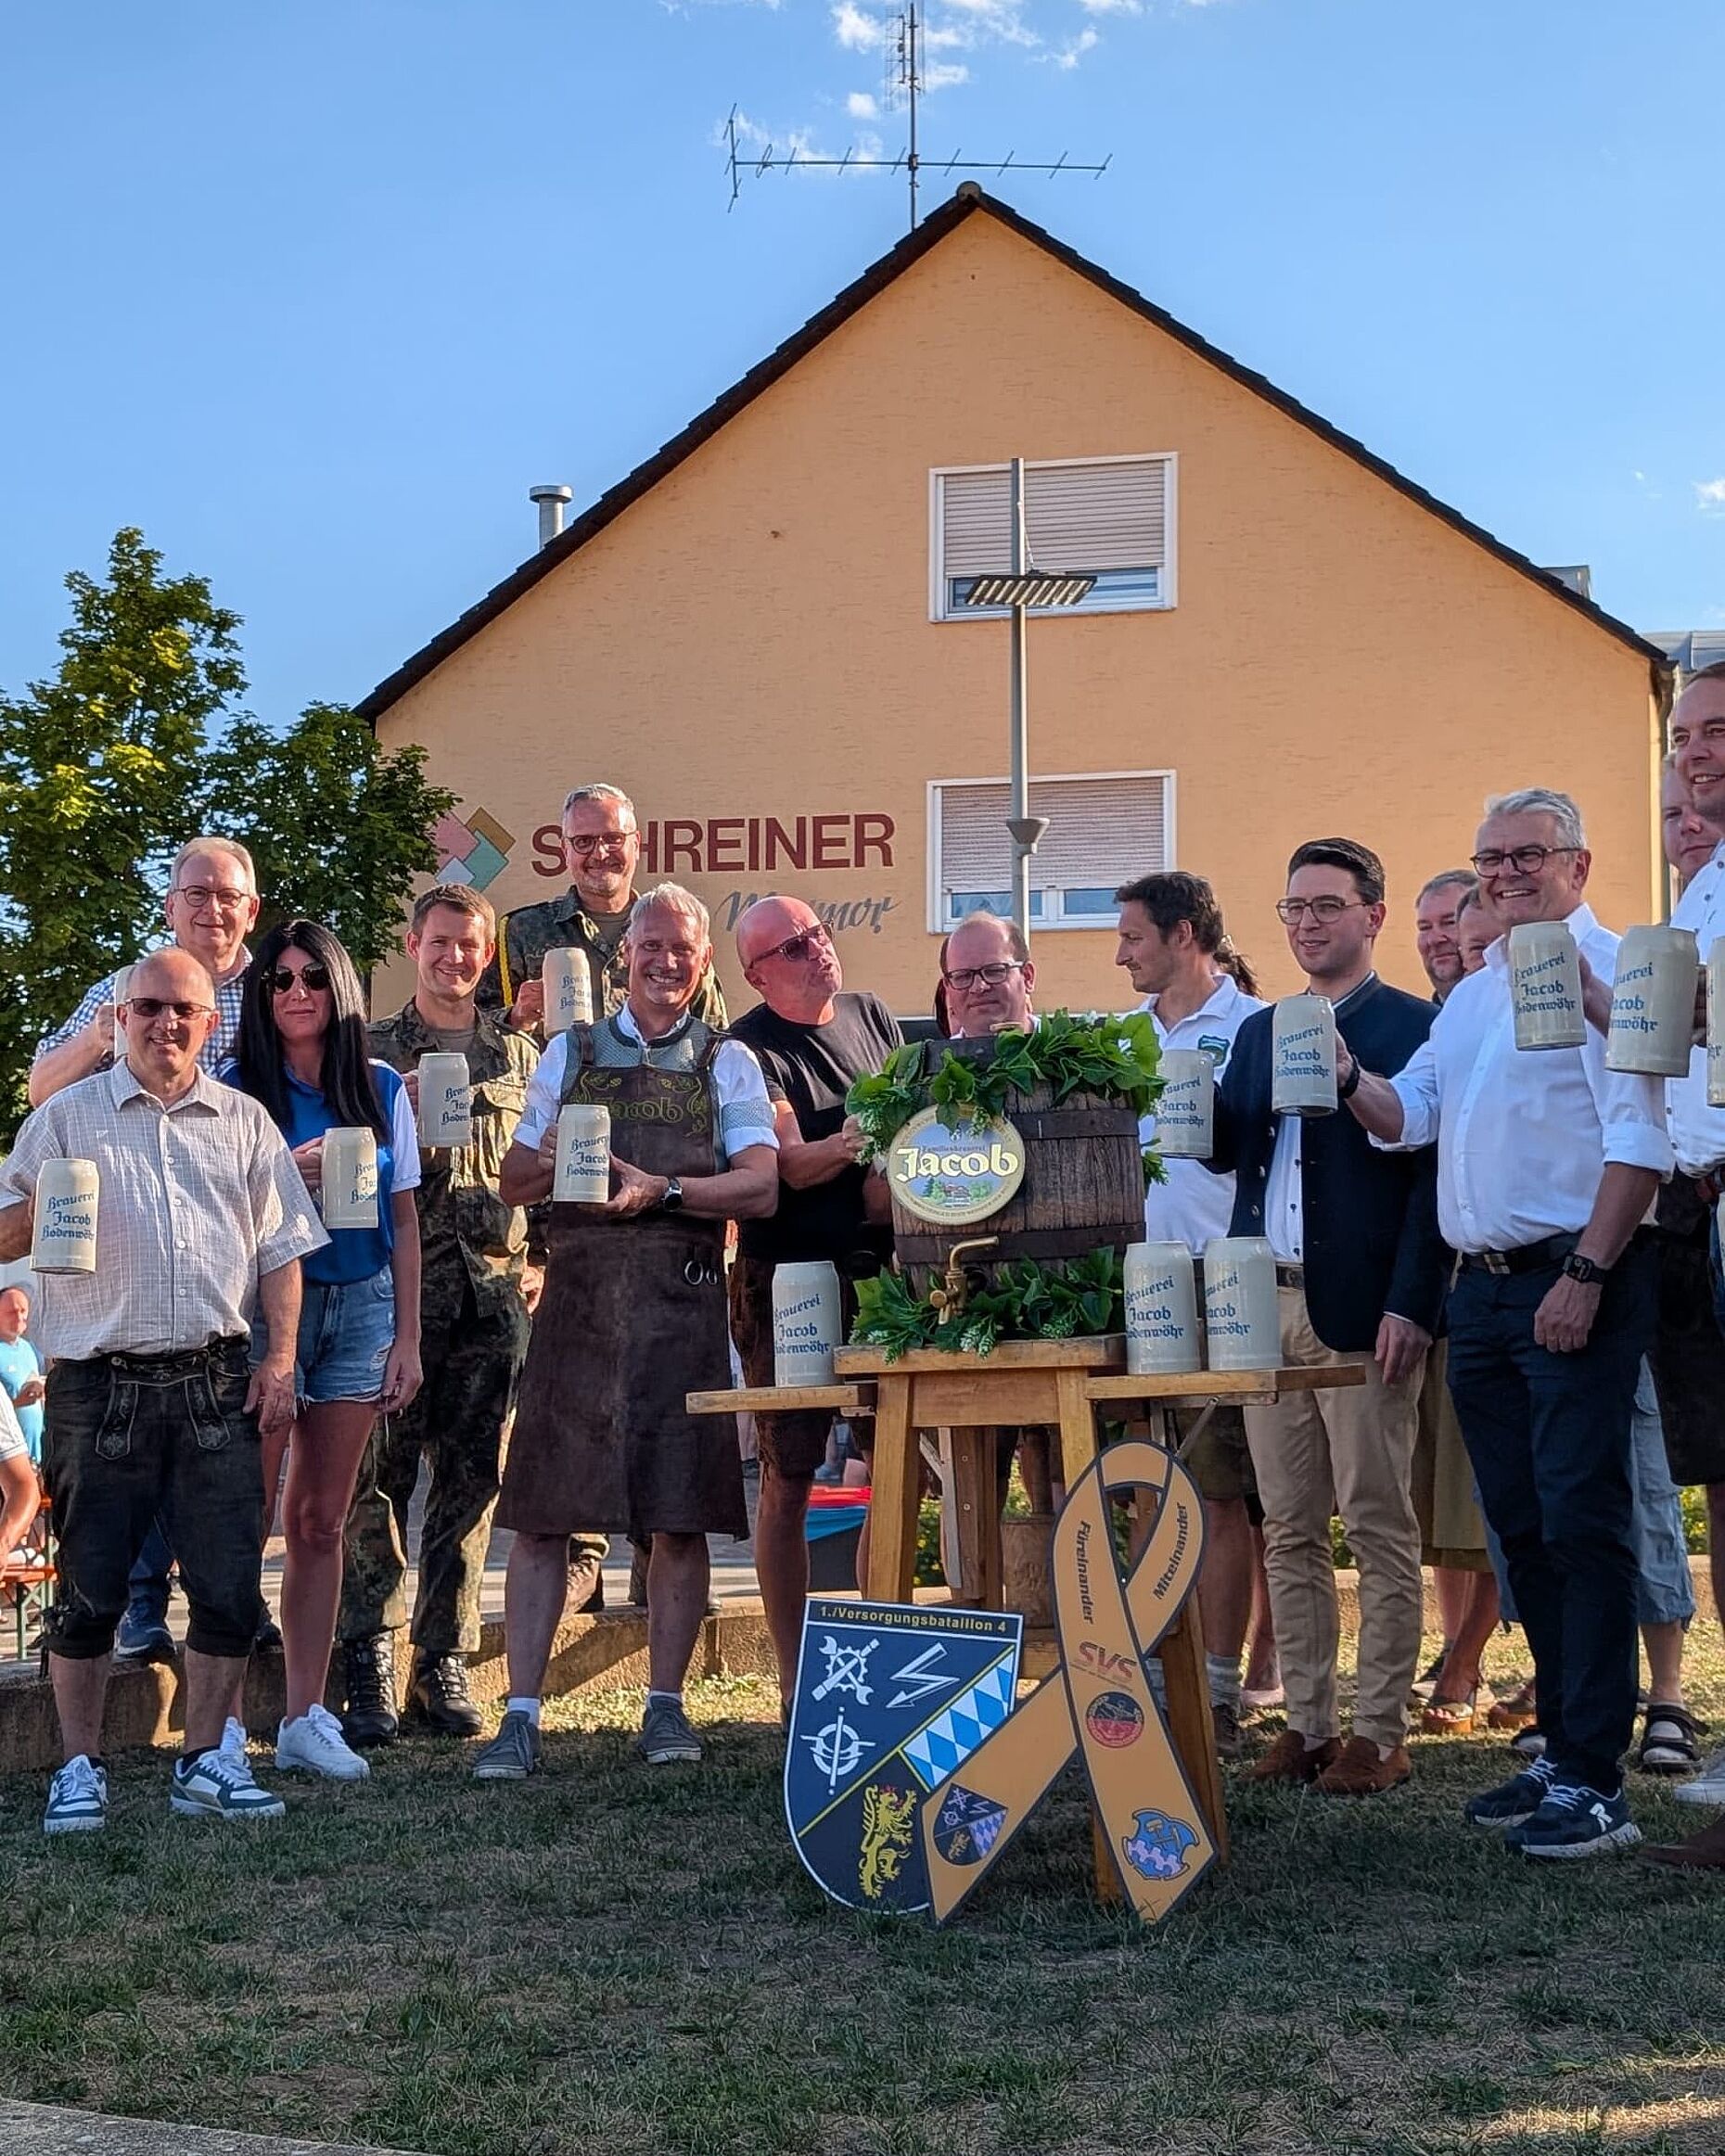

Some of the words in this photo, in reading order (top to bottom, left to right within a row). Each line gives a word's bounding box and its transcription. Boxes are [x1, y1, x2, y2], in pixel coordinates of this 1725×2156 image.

[531, 813, 895, 877] SHREINER
[1522, 980, 1565, 1001] Jacob
[1283, 1049, 1322, 1065] Jacob
[896, 1143, 1019, 1183] Jacob
[53, 1211, 91, 1226] Jacob
[1130, 1306, 1172, 1325] Jacob
[1207, 1303, 1236, 1319] acob
[779, 1322, 818, 1342] Jacob
[1153, 1501, 1189, 1600] Miteinander
[1076, 1520, 1094, 1625] Füreinander
[997, 1621, 1007, 1633] 4
